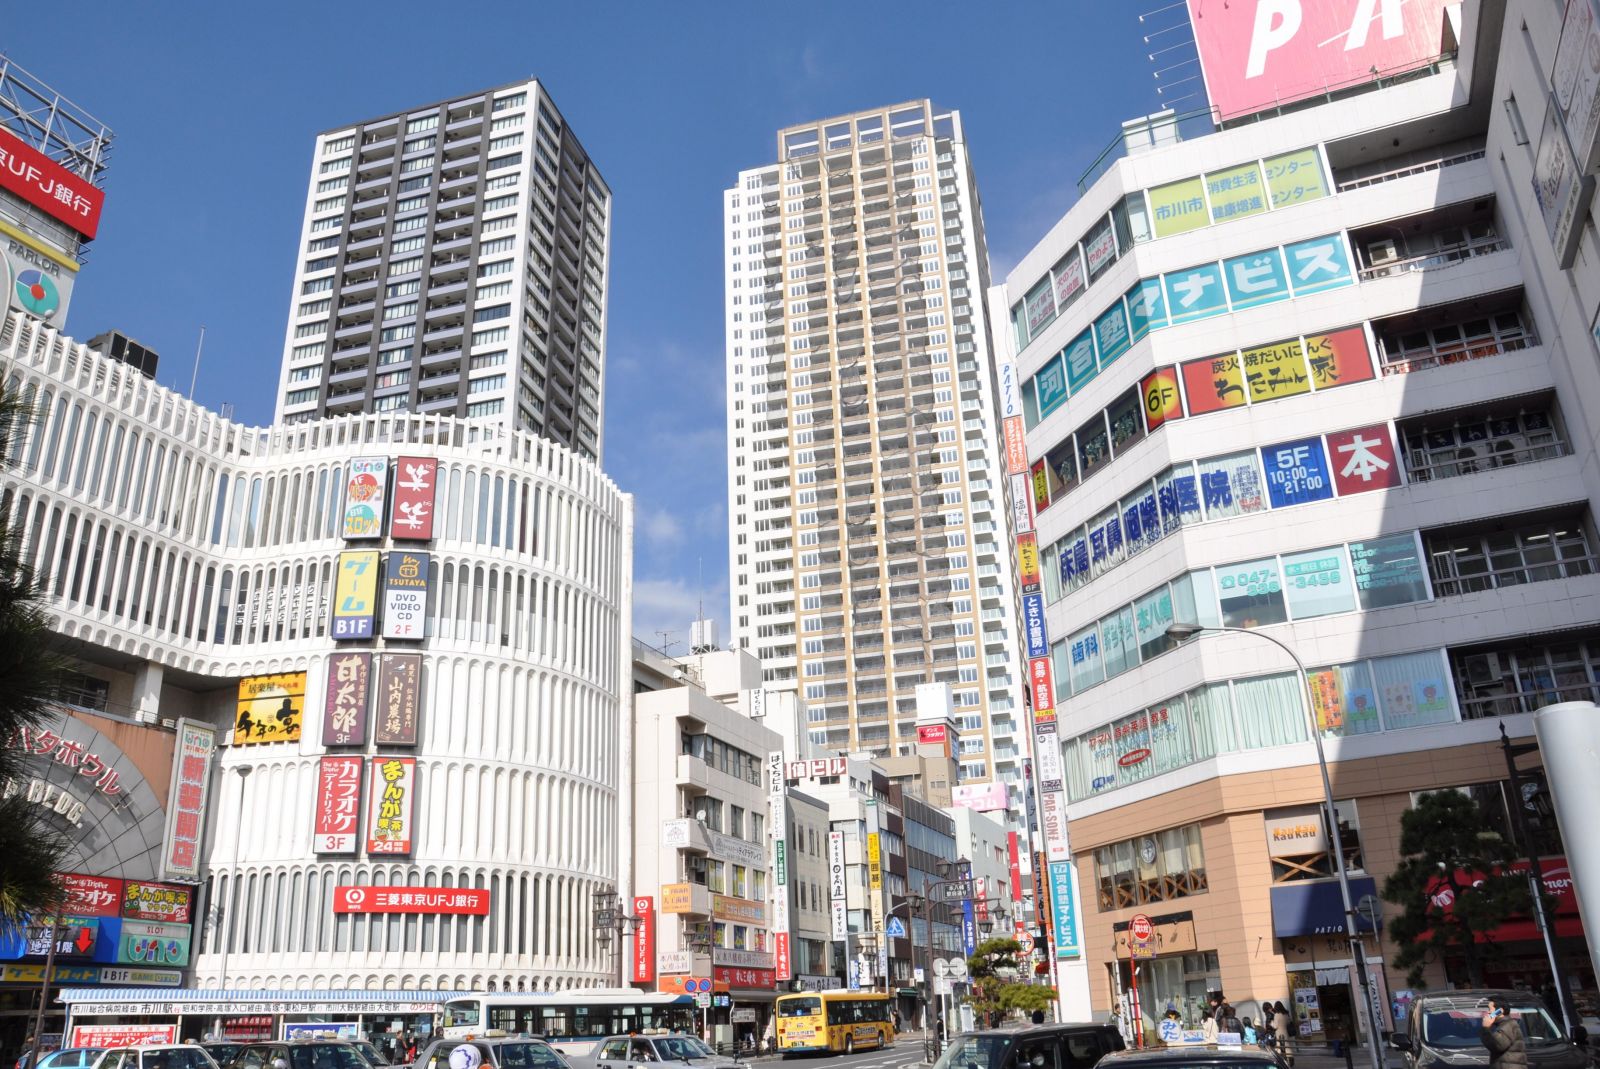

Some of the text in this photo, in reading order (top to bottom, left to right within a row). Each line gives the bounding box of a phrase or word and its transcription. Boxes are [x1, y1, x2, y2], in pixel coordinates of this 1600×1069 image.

[1207, 159, 1314, 194] 消費生活センター
[1156, 198, 1203, 222] 市川市
[1212, 185, 1319, 219] 健康増進センター
[8, 239, 62, 279] PARLOR
[1003, 365, 1013, 415] PATIO
[1147, 387, 1173, 413] 6F
[1277, 446, 1310, 470] 5F
[1337, 434, 1390, 482] 本
[1285, 475, 1323, 495] 21:00
[341, 556, 373, 612] ゲーム
[389, 578, 426, 588] TSUTAYA
[390, 602, 421, 612] VIDEO
[395, 593, 417, 602] DVD
[336, 619, 368, 635] B1F
[397, 612, 413, 621] CD
[1028, 597, 1043, 649] ときわ書房
[1071, 632, 1099, 666] 歯科
[332, 655, 363, 733] 甘太郎
[335, 733, 351, 744] 3F
[790, 757, 848, 780] 信ビル
[27, 778, 87, 830] BLDG.
[333, 760, 359, 832] カラオケ
[326, 835, 346, 850] 3F
[373, 840, 393, 852] 24
[375, 892, 480, 909] 三菱東京UFJ銀行
[147, 926, 164, 935] SLOT
[1315, 925, 1343, 934] PATIO
[110, 970, 129, 982] B1F
[72, 1005, 138, 1014] 市川総合病院経由
[140, 1003, 174, 1014] 市川駅
[409, 1002, 436, 1011] のりば
[104, 1036, 158, 1047] アーバンホ
